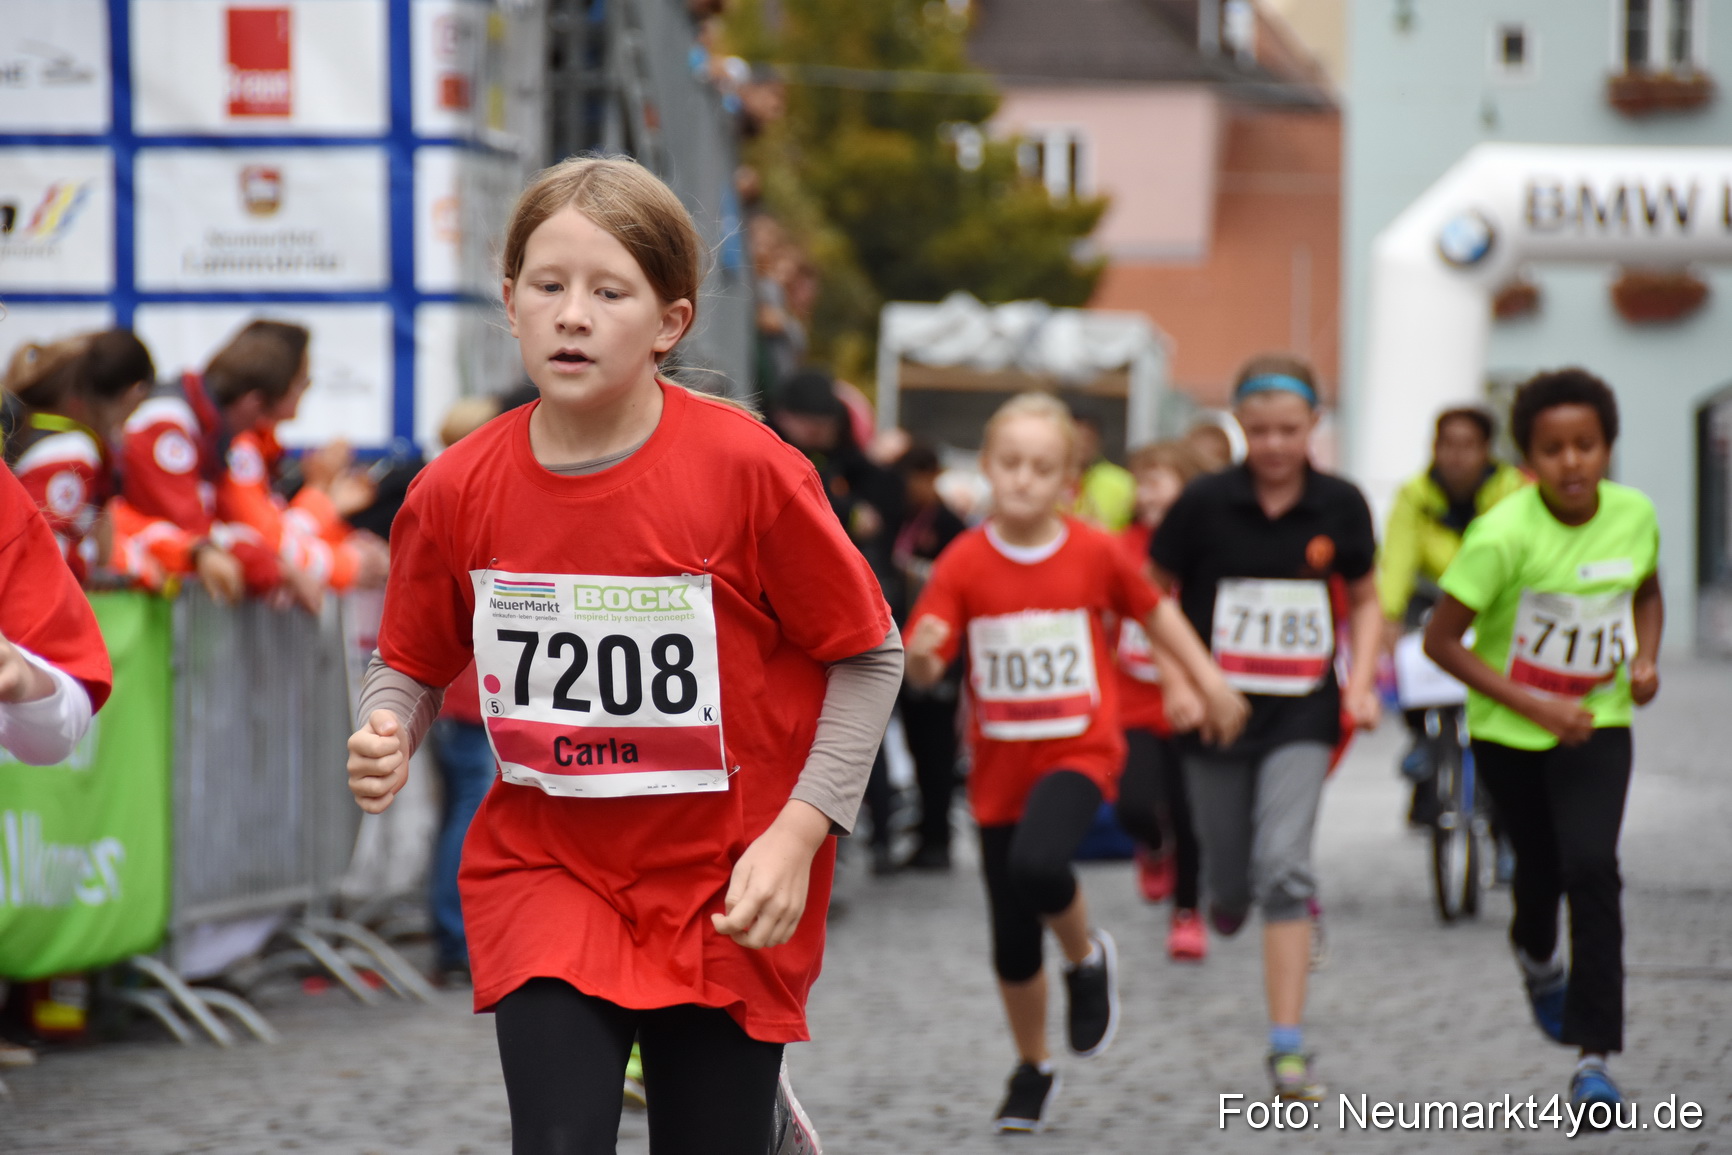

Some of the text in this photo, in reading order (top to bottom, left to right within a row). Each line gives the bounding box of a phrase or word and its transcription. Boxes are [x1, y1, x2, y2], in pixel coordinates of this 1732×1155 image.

[1526, 181, 1699, 228] BMW
[489, 597, 560, 613] NeuerMarkt
[575, 585, 691, 611] BOCK
[574, 612, 695, 623] inspired by smart concepts
[1230, 605, 1322, 648] 7185
[1531, 614, 1626, 667] 7115
[496, 628, 698, 716] 7208
[491, 701, 500, 714] 5
[703, 707, 713, 721] K
[553, 735, 639, 767] Carla
